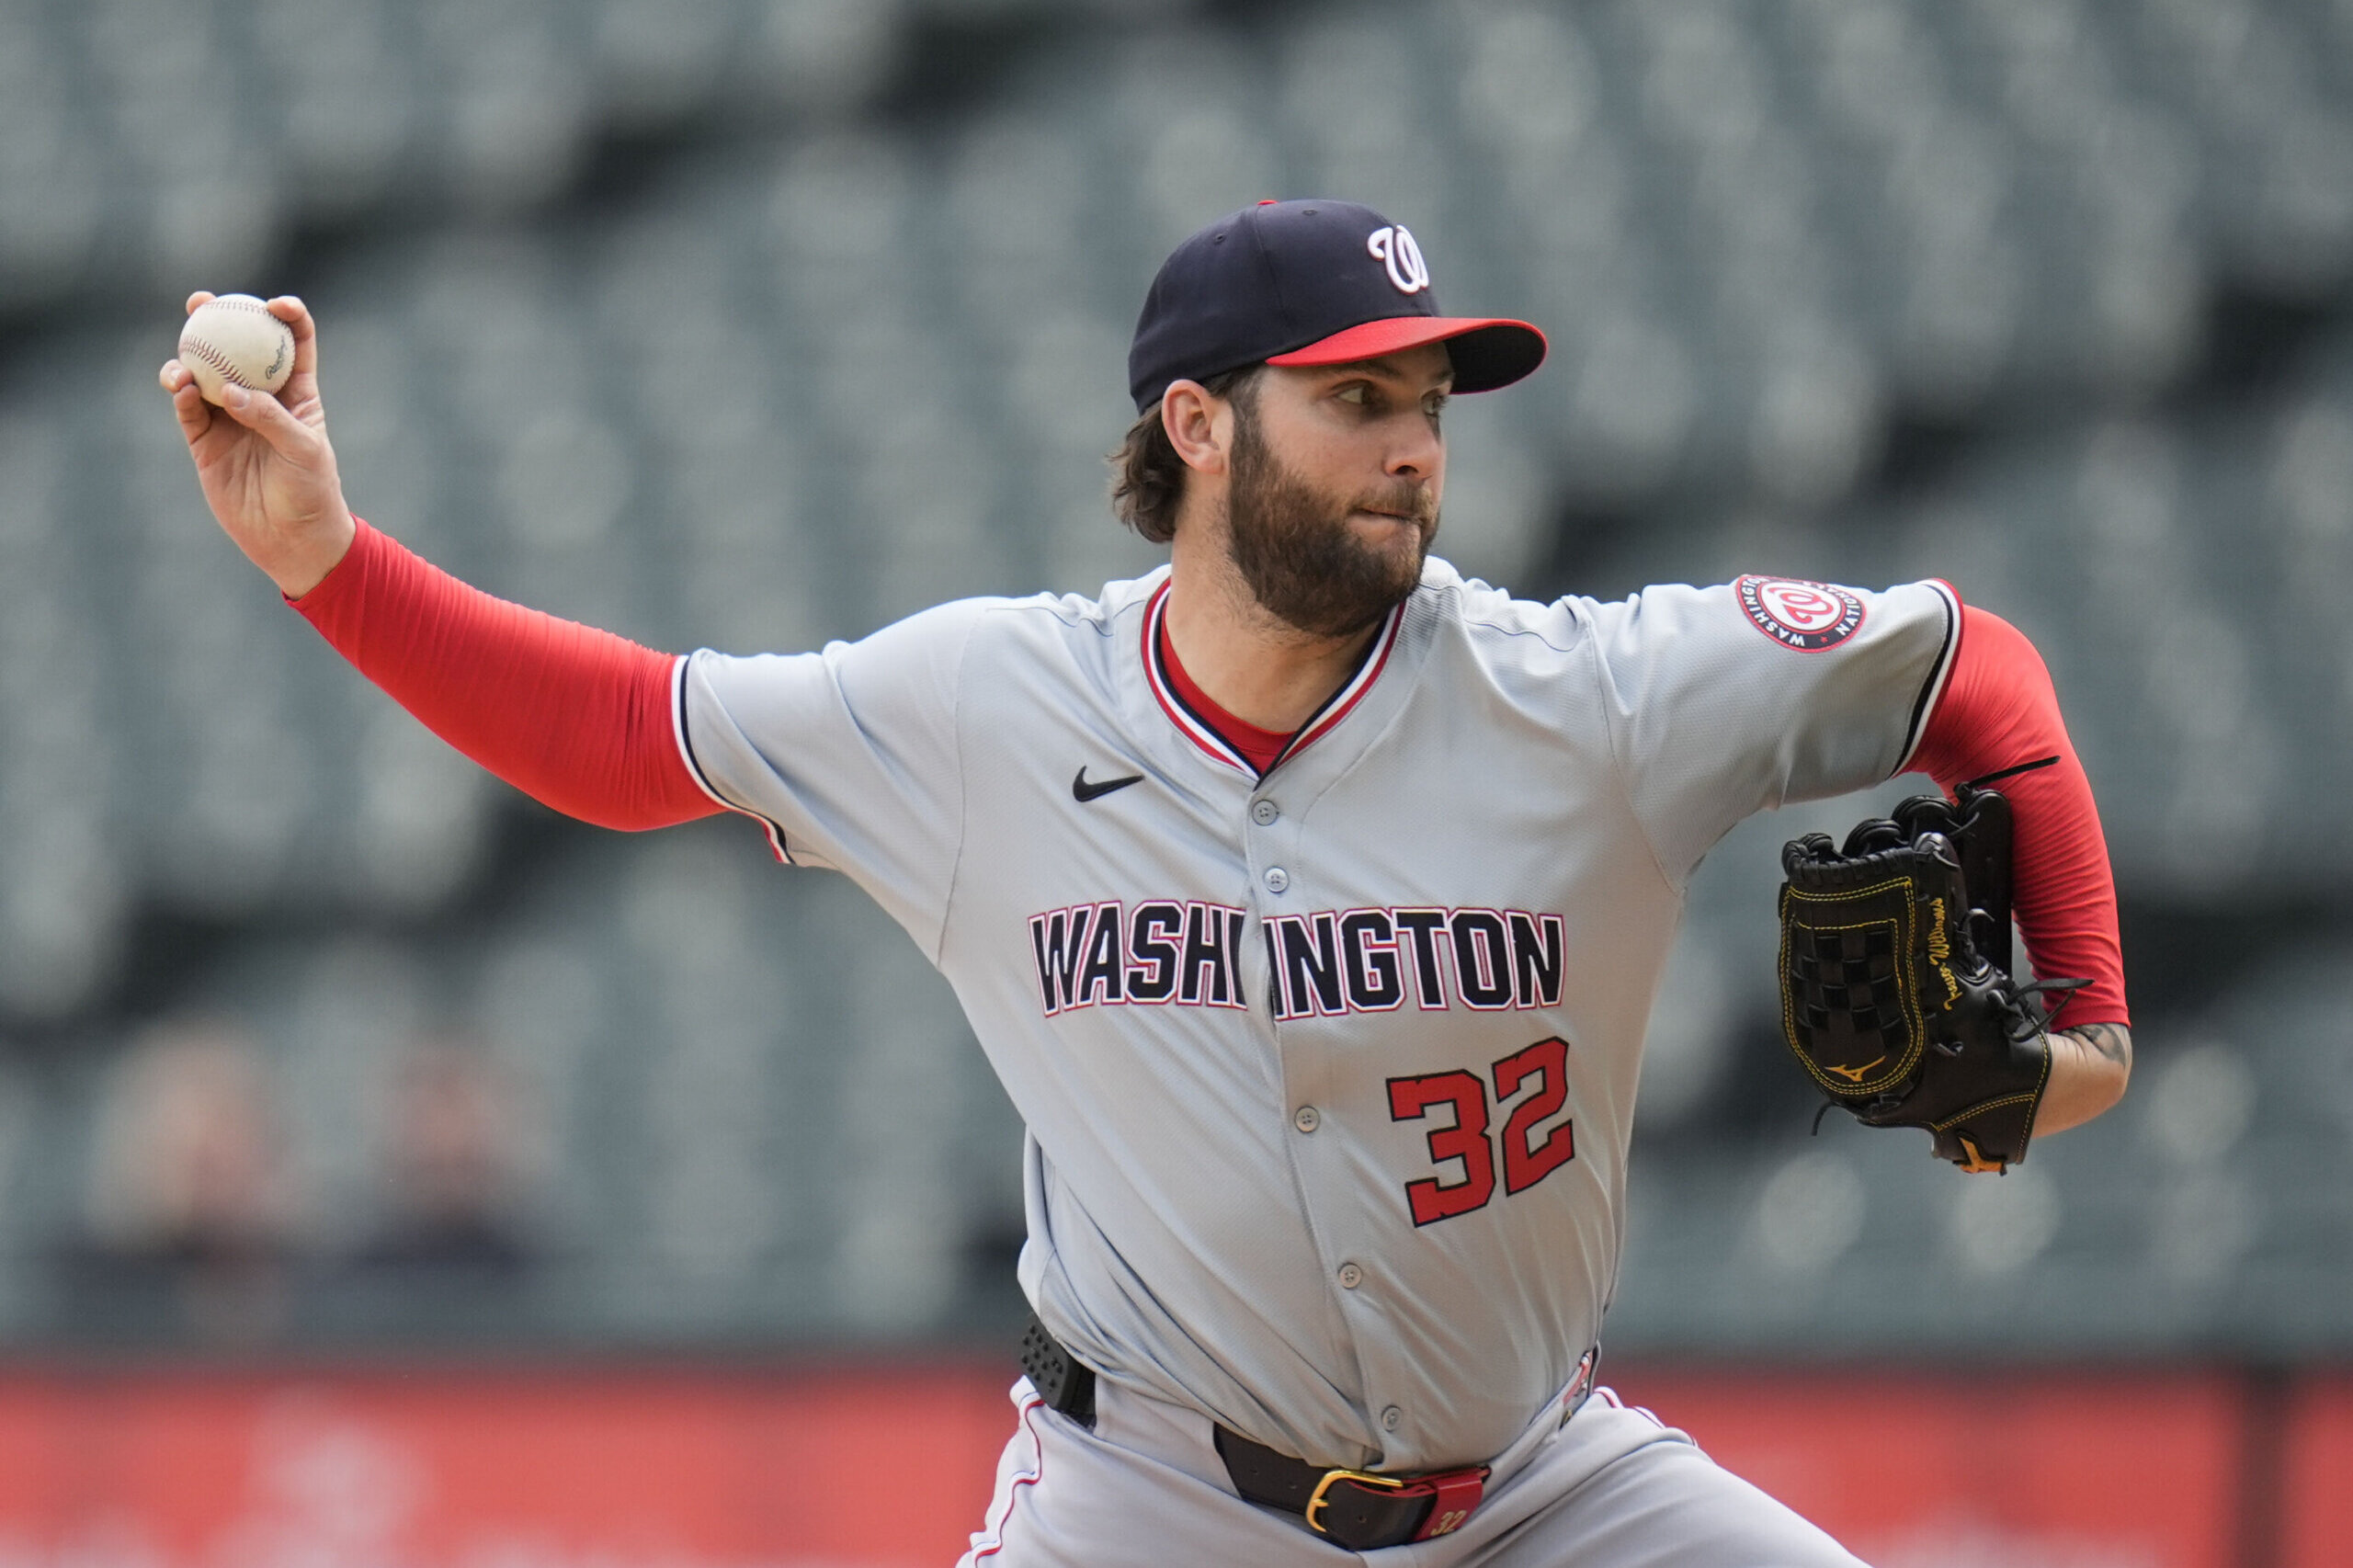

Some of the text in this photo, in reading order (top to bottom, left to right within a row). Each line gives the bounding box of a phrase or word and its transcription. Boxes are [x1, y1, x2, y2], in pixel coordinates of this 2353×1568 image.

[1367, 224, 1429, 294] W
[1029, 900, 1566, 1022] WASHINGTON
[1386, 1037, 1575, 1228] 32
[1430, 1510, 1467, 1536] 32
